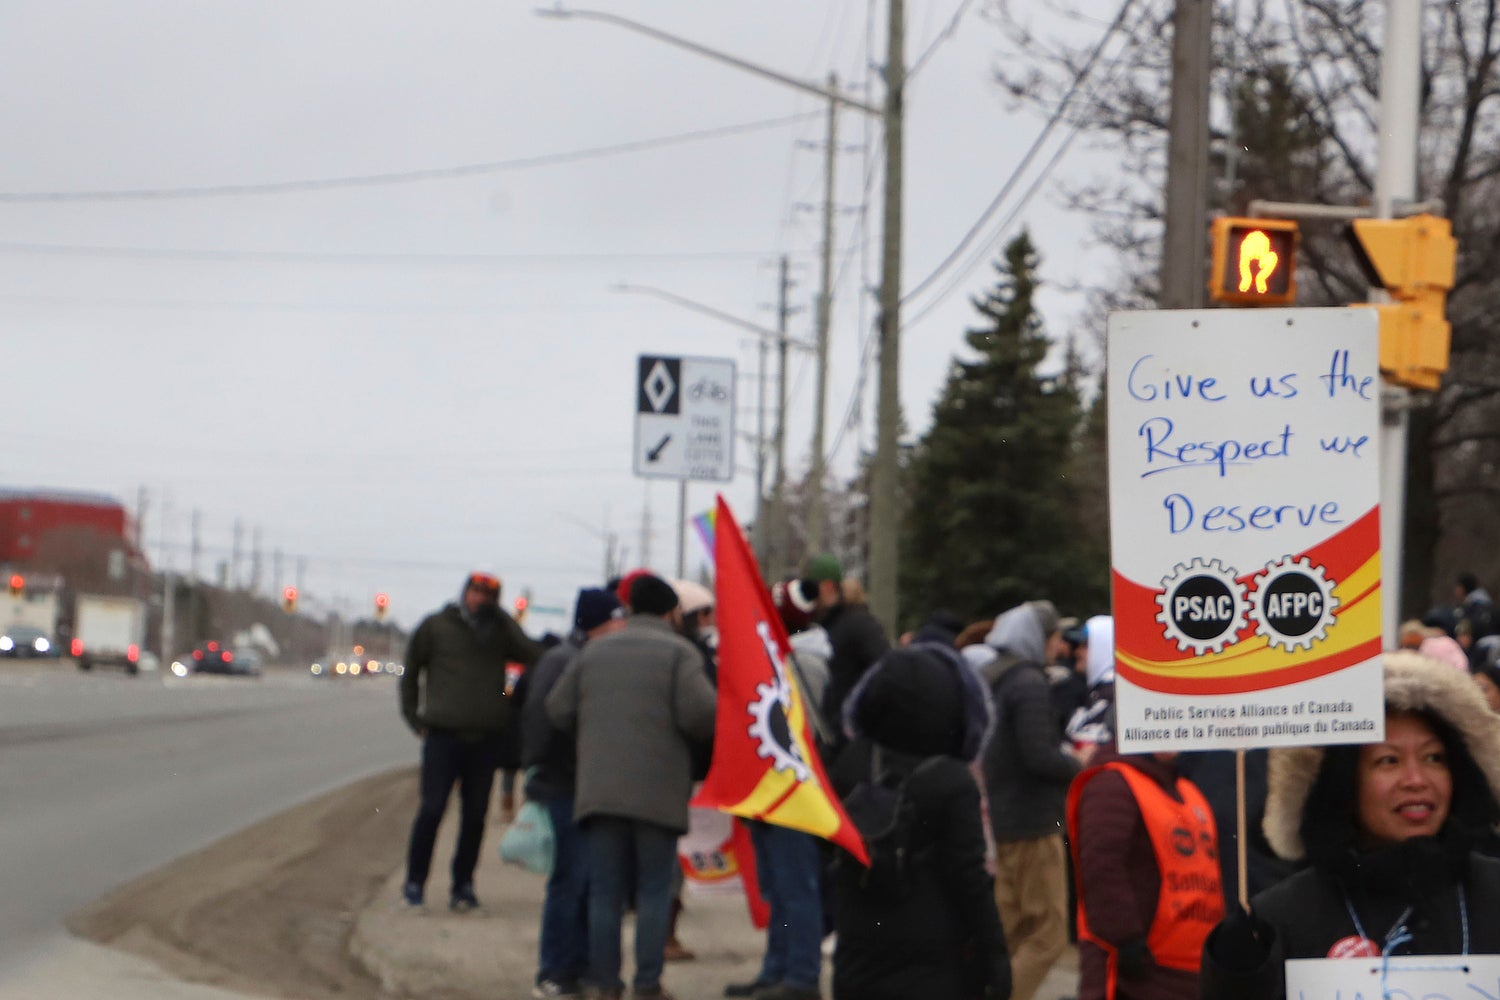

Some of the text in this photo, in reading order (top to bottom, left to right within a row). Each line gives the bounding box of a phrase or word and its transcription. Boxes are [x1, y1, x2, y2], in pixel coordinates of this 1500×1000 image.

[1128, 350, 1374, 402] Give us the
[1138, 417, 1372, 477] Respect we
[1162, 493, 1343, 534] Deserve
[1174, 594, 1232, 622] PSAC
[1266, 591, 1323, 618] AFPC
[1144, 700, 1354, 720] Public Service Alliance of Canada
[1124, 718, 1376, 741] Alliance de la Fonction publique du Canada
